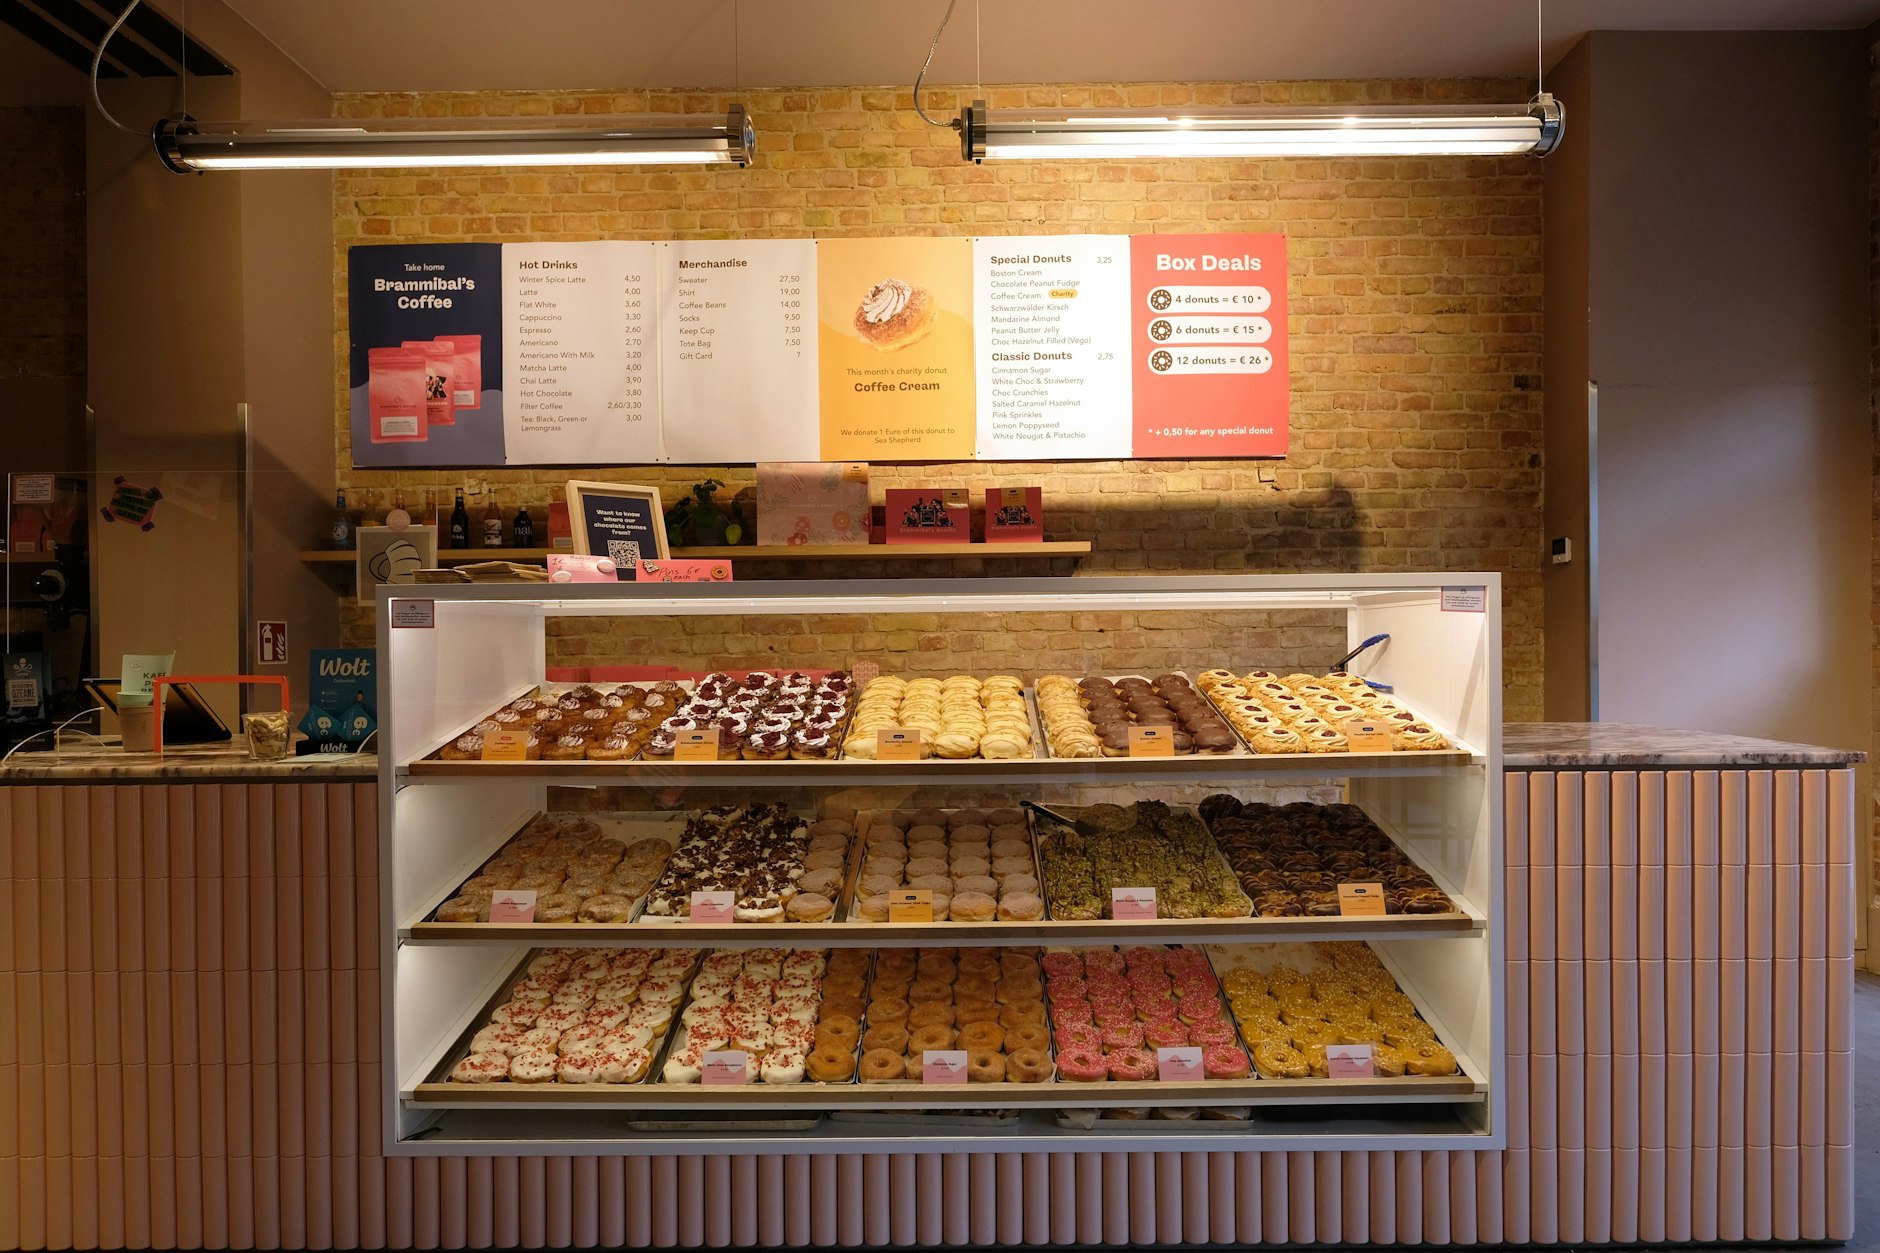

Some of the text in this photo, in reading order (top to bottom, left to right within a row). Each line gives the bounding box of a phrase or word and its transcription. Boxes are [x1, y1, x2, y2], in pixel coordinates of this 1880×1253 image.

[520, 260, 577, 269] Hot Drinks
[679, 258, 747, 268] Merchandise
[991, 255, 1029, 265] Special
[1033, 255, 1071, 263] Donuts
[1157, 255, 1262, 270] Box Deals
[424, 263, 445, 271] home
[546, 276, 565, 284] Spice
[625, 275, 640, 283] 4,50
[780, 275, 800, 283] 27,50
[375, 277, 475, 291] Brammibal's
[1057, 280, 1080, 288] Fudge
[780, 288, 800, 296] 19,00
[398, 295, 452, 309] Coffee
[1175, 295, 1181, 303] 4
[1185, 295, 1219, 303] donuts
[1232, 295, 1238, 303] €
[991, 304, 1045, 312] Schwarzwälder
[519, 312, 641, 323] Cappuccino 3,30
[520, 327, 551, 335] Espresso
[680, 328, 698, 336] Keep
[700, 327, 715, 335] Cup
[1043, 326, 1059, 335] Jelly
[1176, 325, 1254, 334] 6 donuts € 15
[520, 338, 558, 346] Americano
[680, 338, 800, 348] Tote Bag 7,50
[1068, 337, 1091, 345] (Vego)
[626, 350, 641, 359] 3,20
[992, 352, 1030, 361] Classic
[1034, 352, 1072, 360] Donuts
[1192, 356, 1226, 364] donuts
[1240, 356, 1245, 364] €
[1249, 356, 1261, 364] 26
[625, 363, 641, 371] 4,00
[1030, 366, 1051, 375] Sugar
[1044, 377, 1083, 385] Strawberry
[855, 382, 939, 392] Coffee Cream
[536, 390, 572, 398] Chocolate
[608, 401, 641, 409] 2,60/3,30
[626, 414, 641, 422] 3,00
[1010, 411, 1042, 420] Sprinkles
[926, 426, 946, 434] donut
[1019, 421, 1059, 431] Poppyseed
[1163, 426, 1273, 437] 0,50 for any special donut
[875, 436, 921, 444] Sea Shepherd
[1016, 432, 1043, 441] Nougat
[319, 657, 370, 677] Wolt
[320, 743, 348, 753] Wolt
